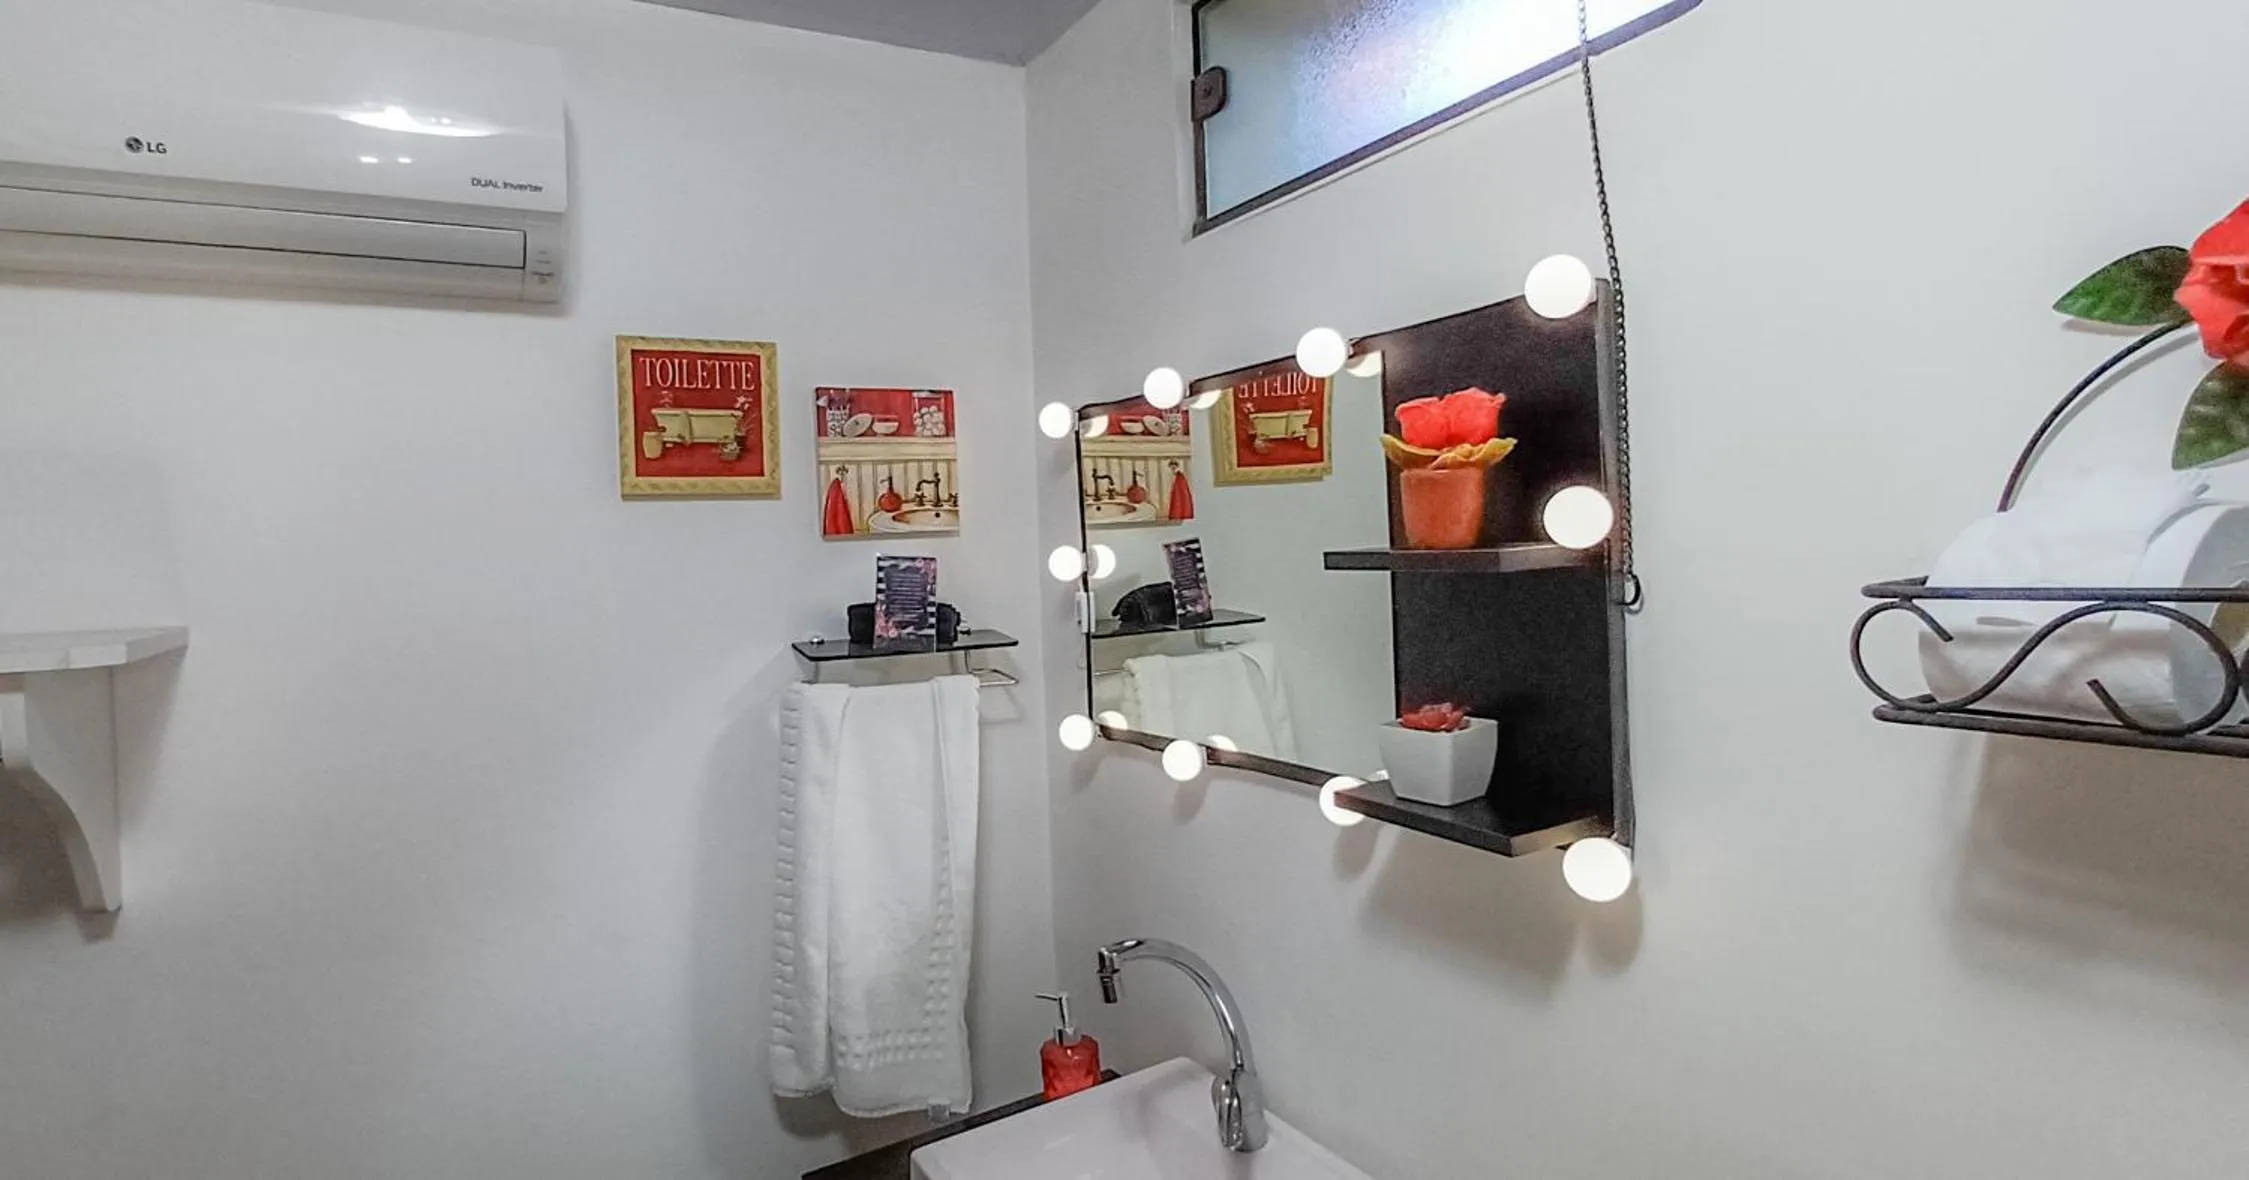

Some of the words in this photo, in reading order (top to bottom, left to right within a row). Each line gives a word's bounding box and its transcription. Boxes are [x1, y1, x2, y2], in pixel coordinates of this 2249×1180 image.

[146, 141, 168, 154] LG
[471, 177, 500, 189] DUAL
[640, 357, 755, 391] TOILETTE
